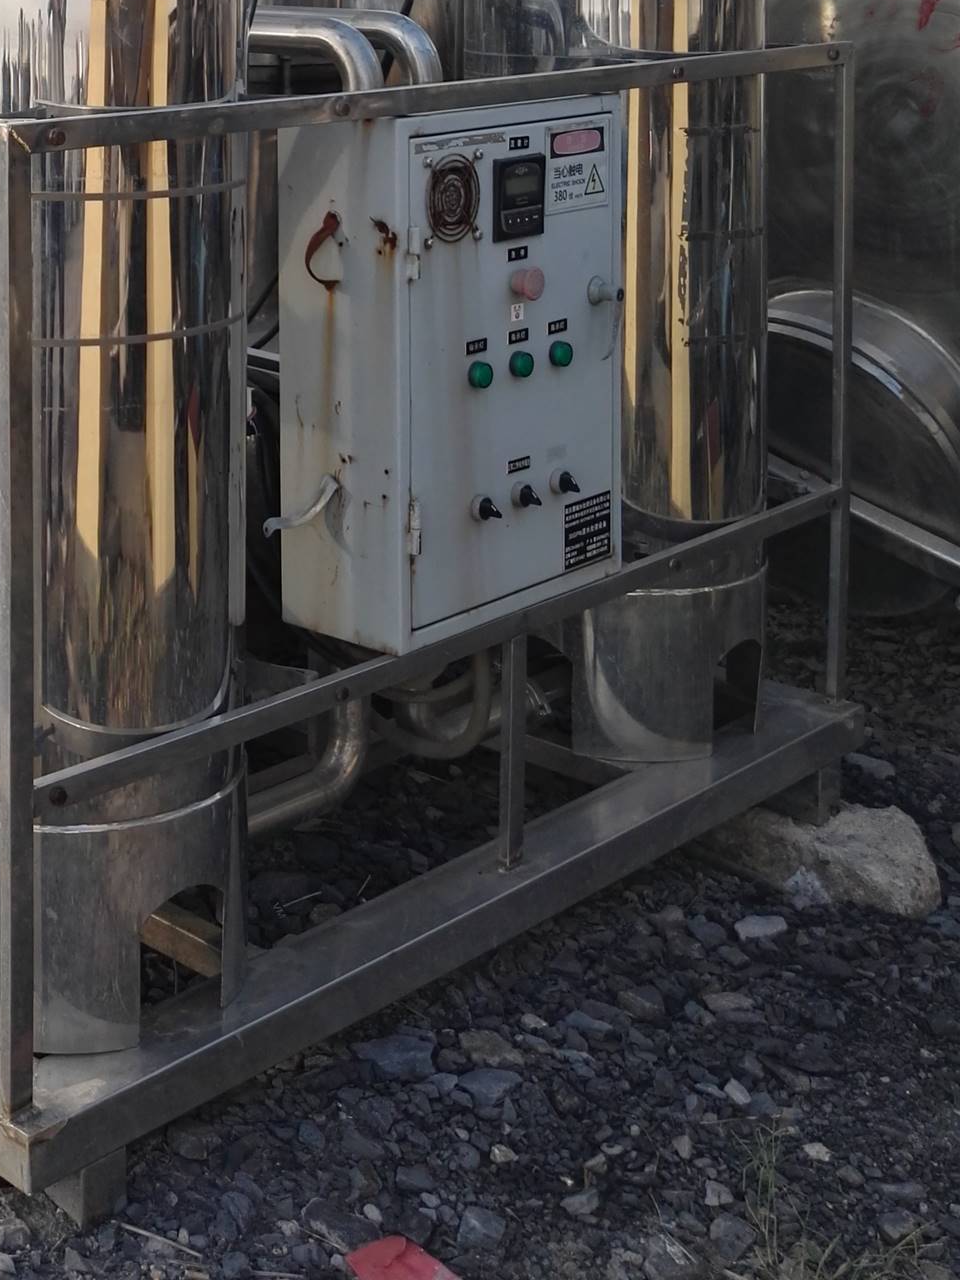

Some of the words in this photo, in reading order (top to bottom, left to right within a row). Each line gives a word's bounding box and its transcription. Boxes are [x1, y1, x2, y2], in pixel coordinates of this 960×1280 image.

[553, 163, 583, 179] 当心触电
[554, 189, 568, 202] 380
